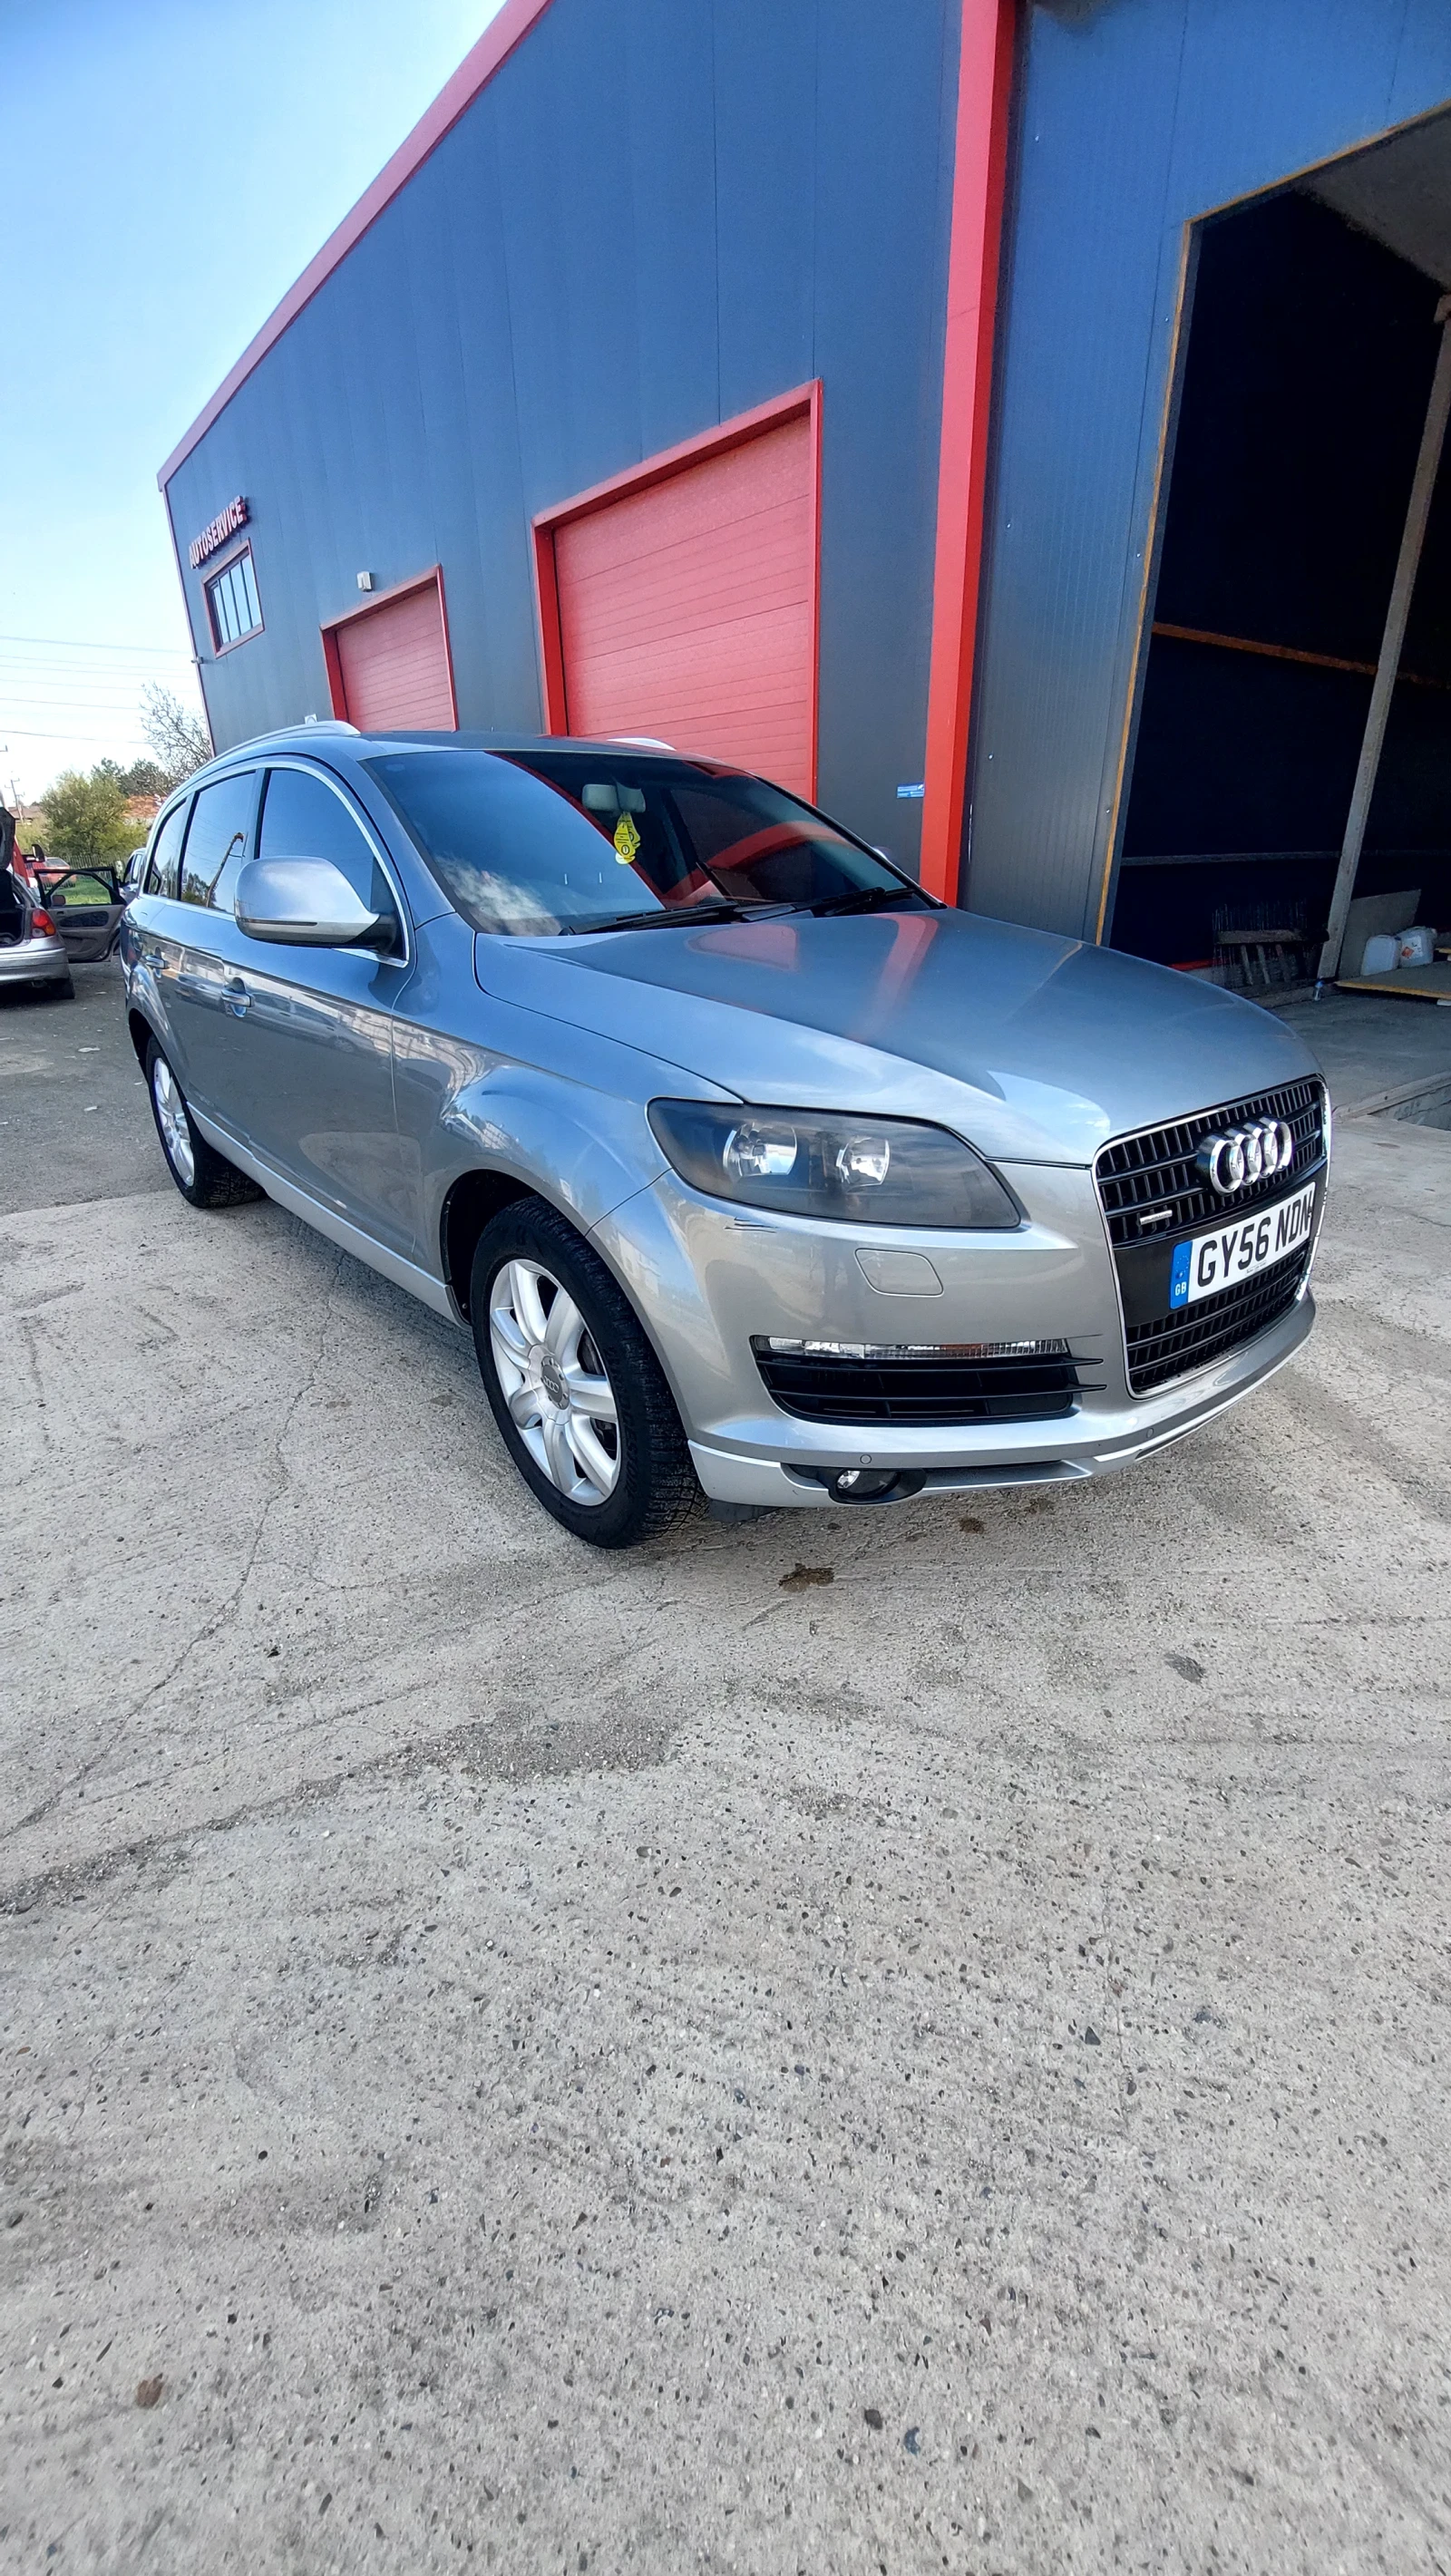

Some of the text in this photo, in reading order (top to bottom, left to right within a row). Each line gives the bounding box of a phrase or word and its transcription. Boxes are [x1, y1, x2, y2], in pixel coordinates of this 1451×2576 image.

[189, 495, 247, 569] AUTOSERVICE
[1197, 1190, 1312, 1288] GY56 NDN
[1174, 1281, 1187, 1297] GB
